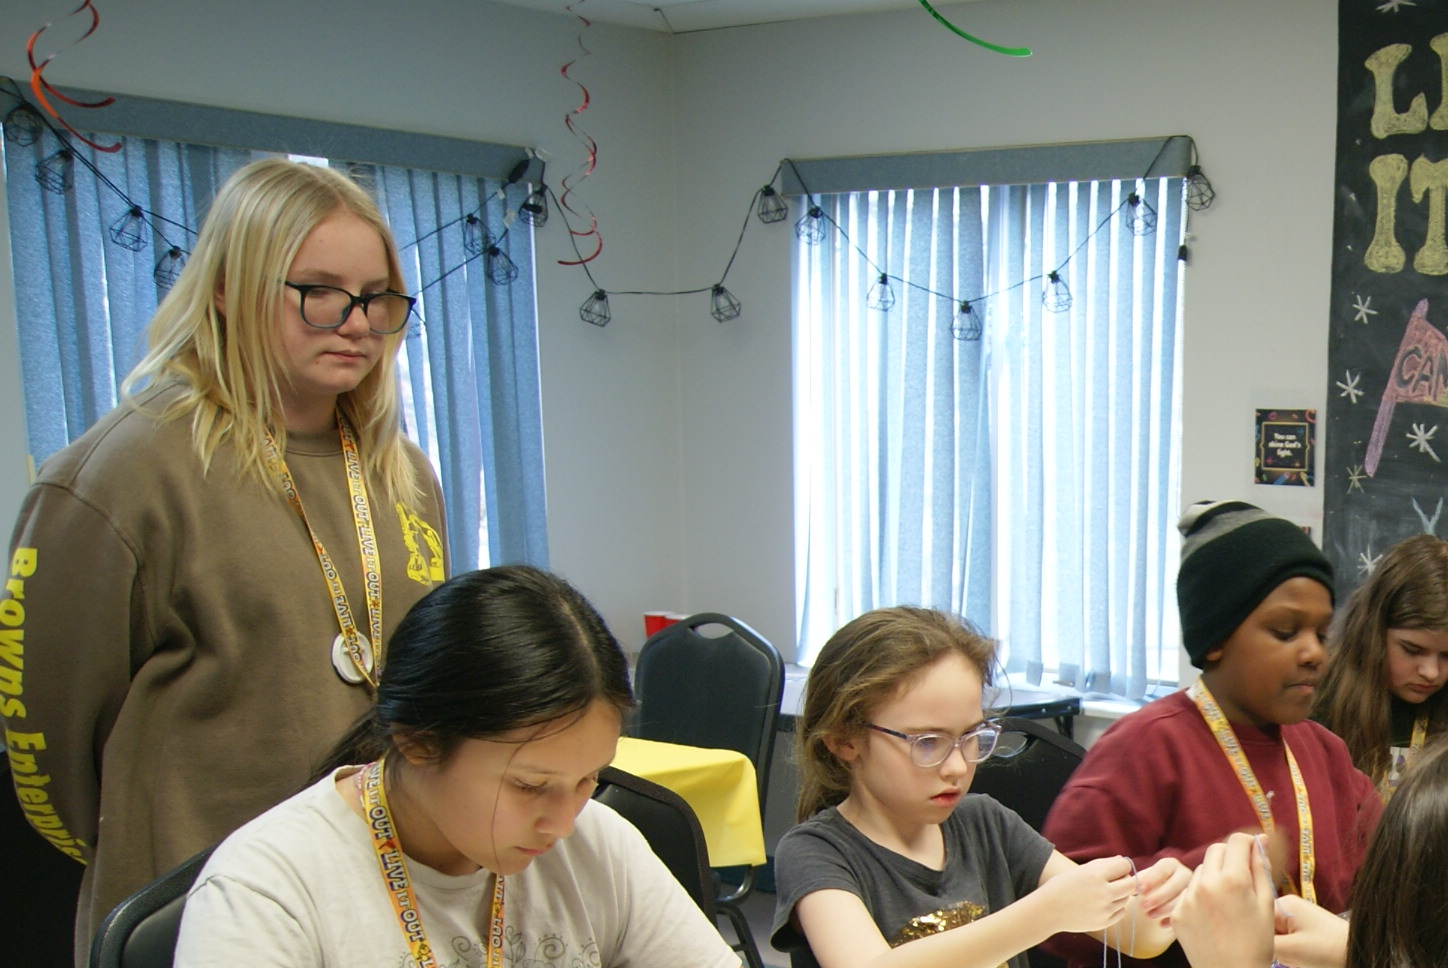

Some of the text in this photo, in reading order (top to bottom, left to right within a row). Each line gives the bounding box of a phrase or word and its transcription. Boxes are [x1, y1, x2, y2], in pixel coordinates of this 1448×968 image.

[0, 547, 38, 719] Browns
[369, 806, 395, 840] OUT
[381, 849, 410, 892] LIVE
[401, 909, 427, 942] OUT
